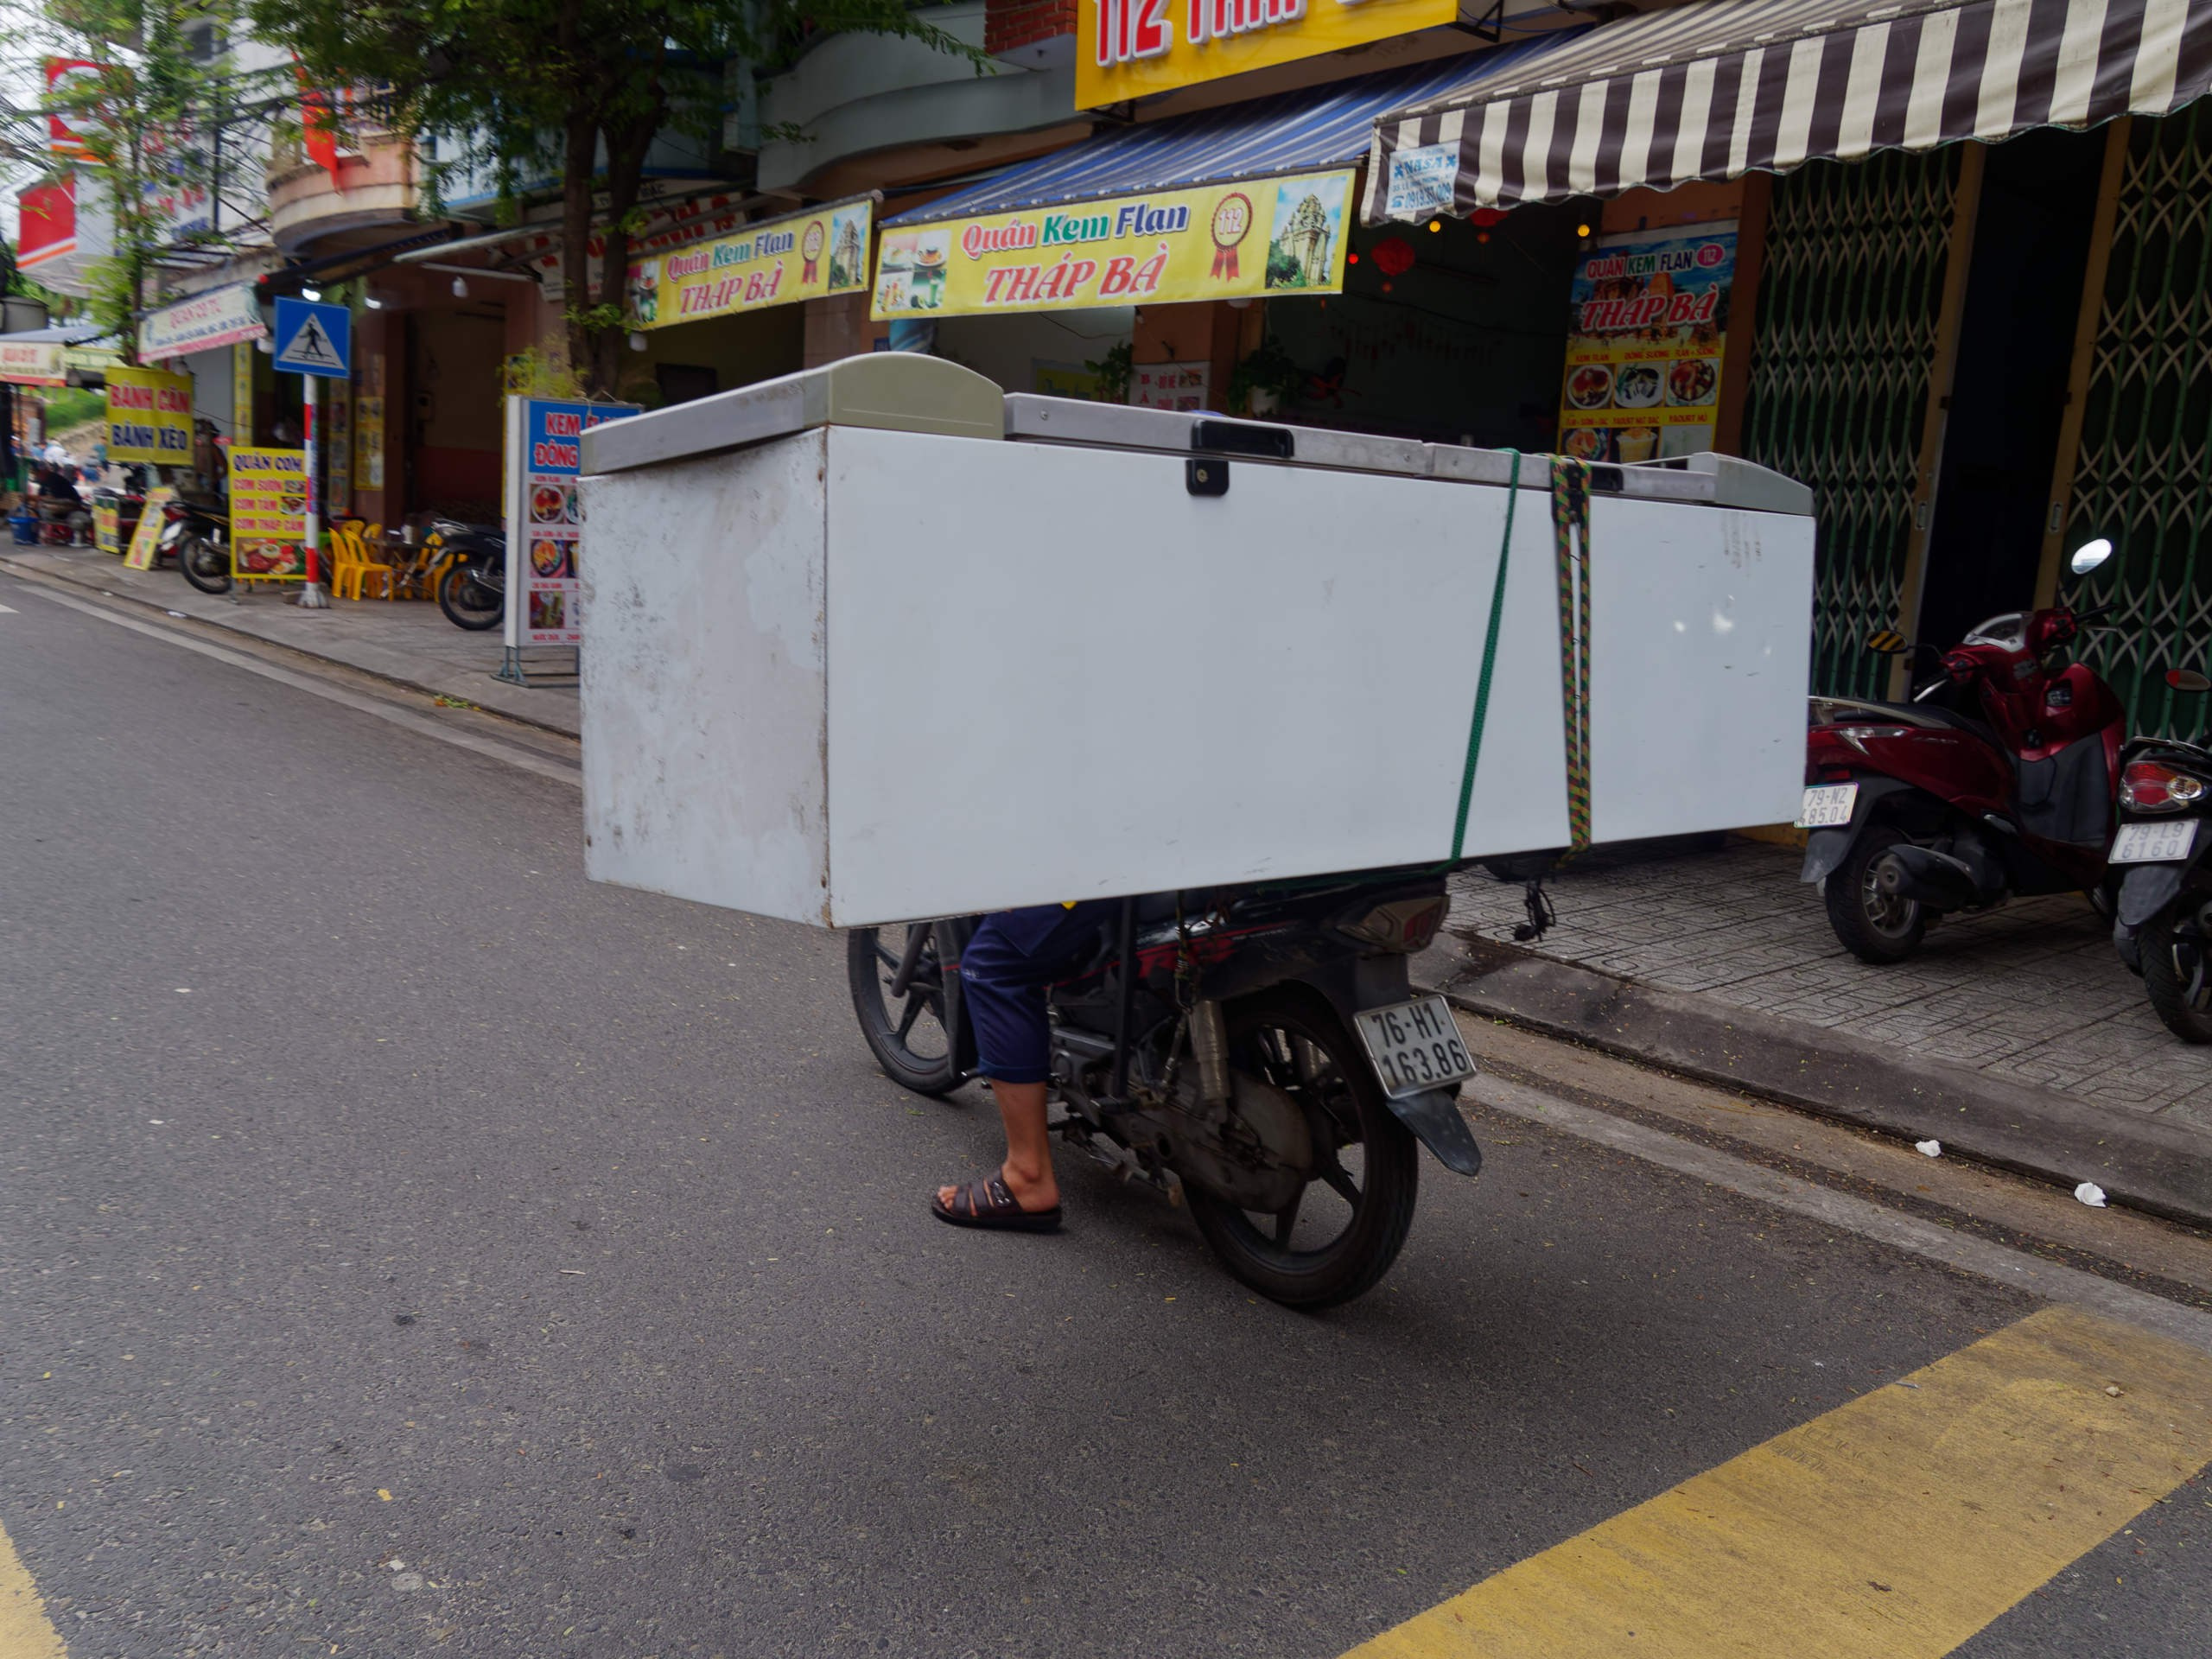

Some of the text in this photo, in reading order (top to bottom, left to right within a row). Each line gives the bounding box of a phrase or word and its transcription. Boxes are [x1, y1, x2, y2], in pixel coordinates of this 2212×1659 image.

[963, 204, 1190, 260] Quán Kem Flan
[1218, 207, 1243, 235] 112
[668, 249, 709, 283] Quán
[713, 244, 751, 267] Kem
[753, 232, 794, 257] Flan
[985, 241, 1167, 304] THÁP BÀ
[1627, 255, 1656, 275] KEM
[1660, 250, 1694, 271] FLAN
[679, 259, 783, 315] THÁP BÀ
[1581, 283, 1719, 332] THÁP BÀ
[545, 412, 581, 436] KEM
[1808, 787, 1847, 806] 79-N2
[2122, 841, 2178, 858] 6160
[1371, 1002, 1442, 1047] 76-H1
[1382, 1039, 1466, 1086] 163.86
